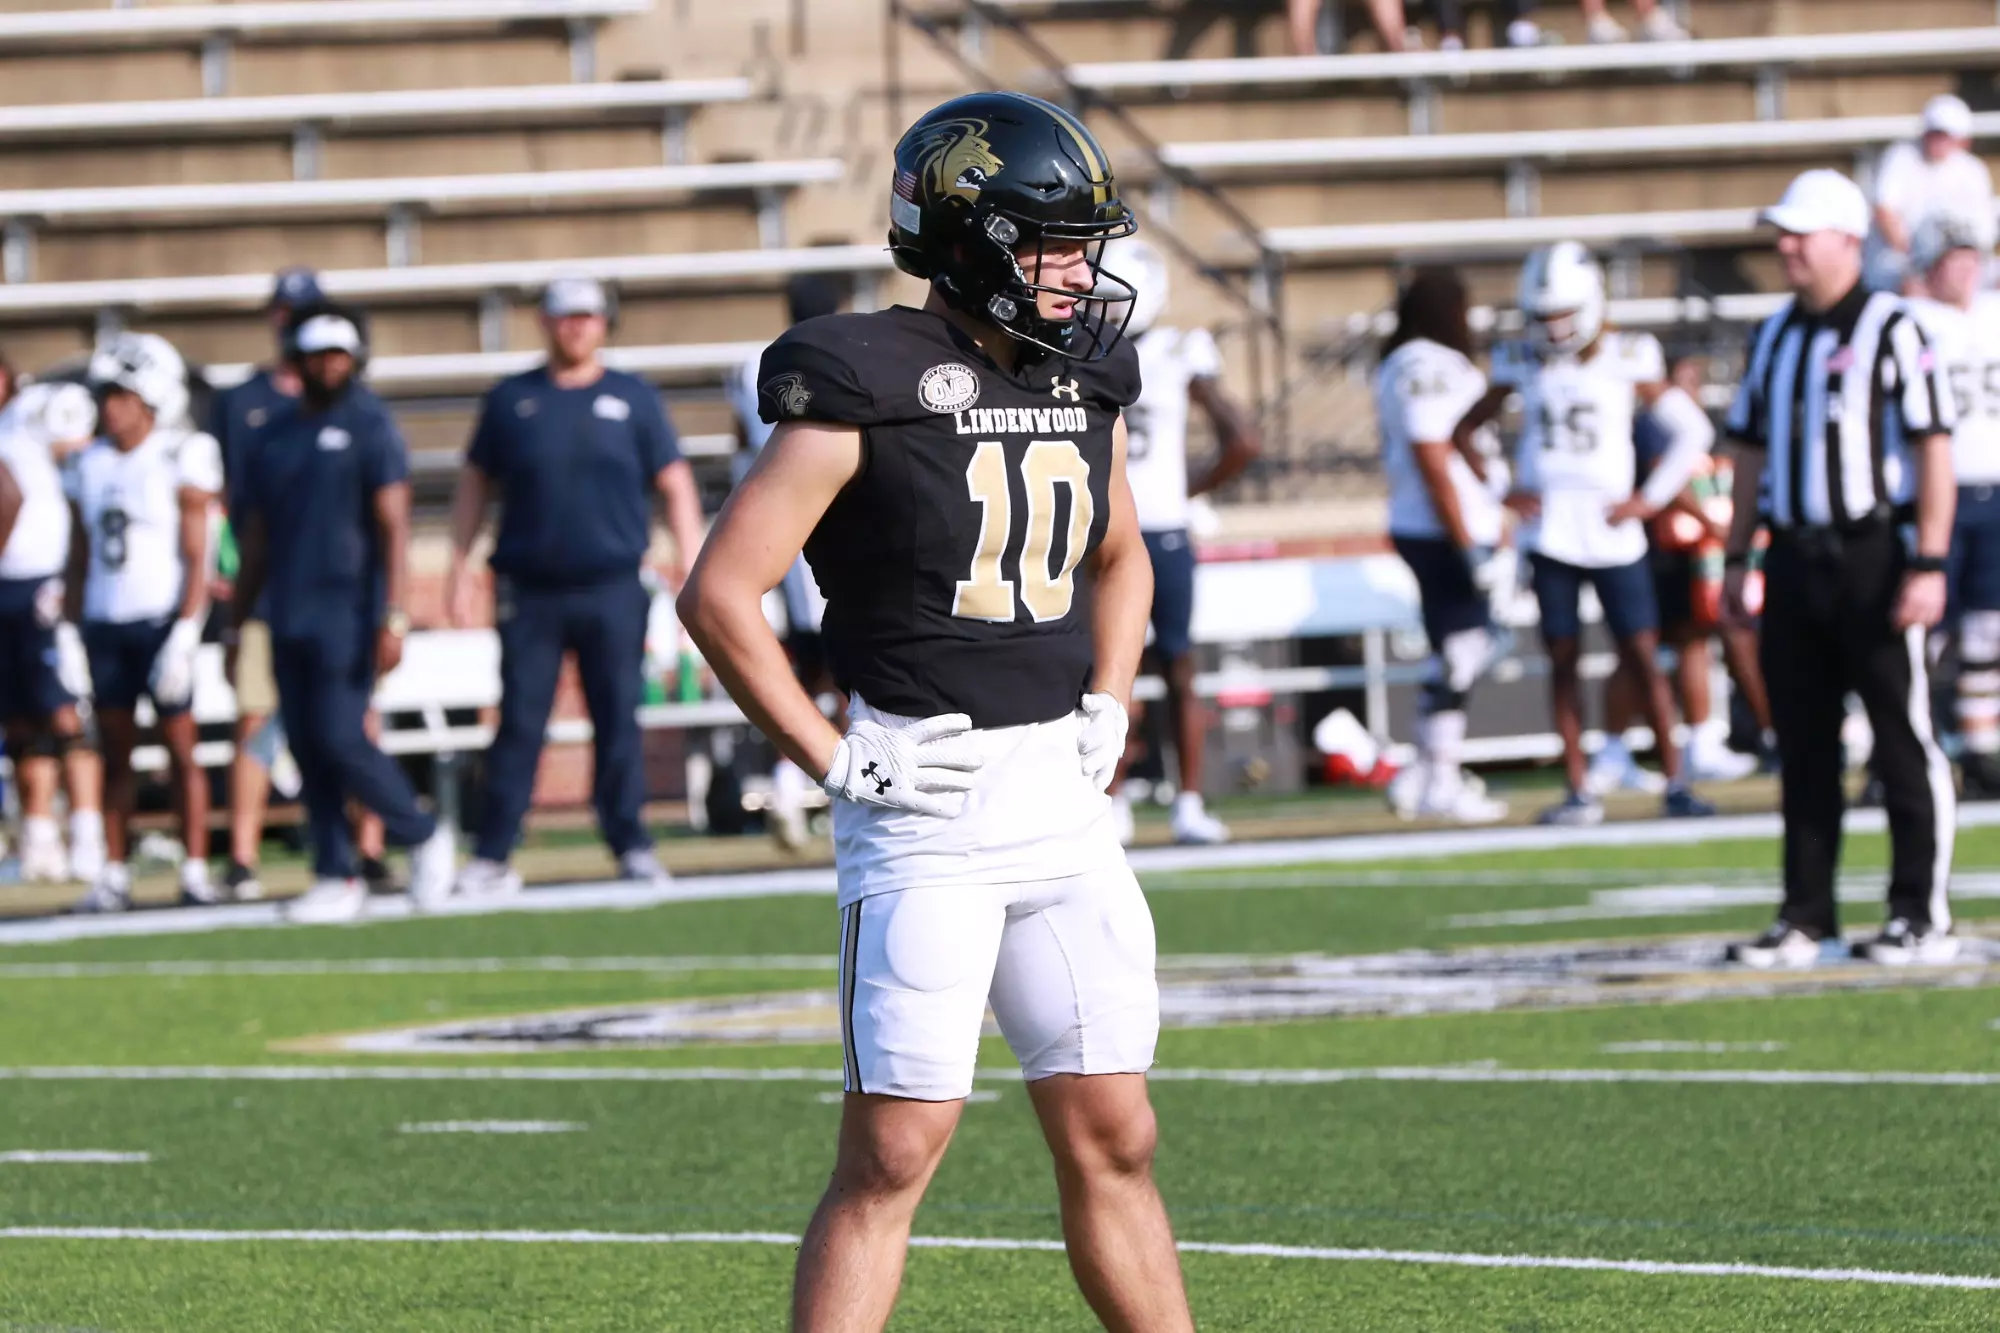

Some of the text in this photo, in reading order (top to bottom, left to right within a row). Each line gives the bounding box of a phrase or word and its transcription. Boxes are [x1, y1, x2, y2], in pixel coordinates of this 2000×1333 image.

[954, 408, 1088, 435] LINDENWOOD
[1539, 403, 1597, 452] 15
[99, 508, 128, 567] 8
[951, 440, 1094, 623] 10
